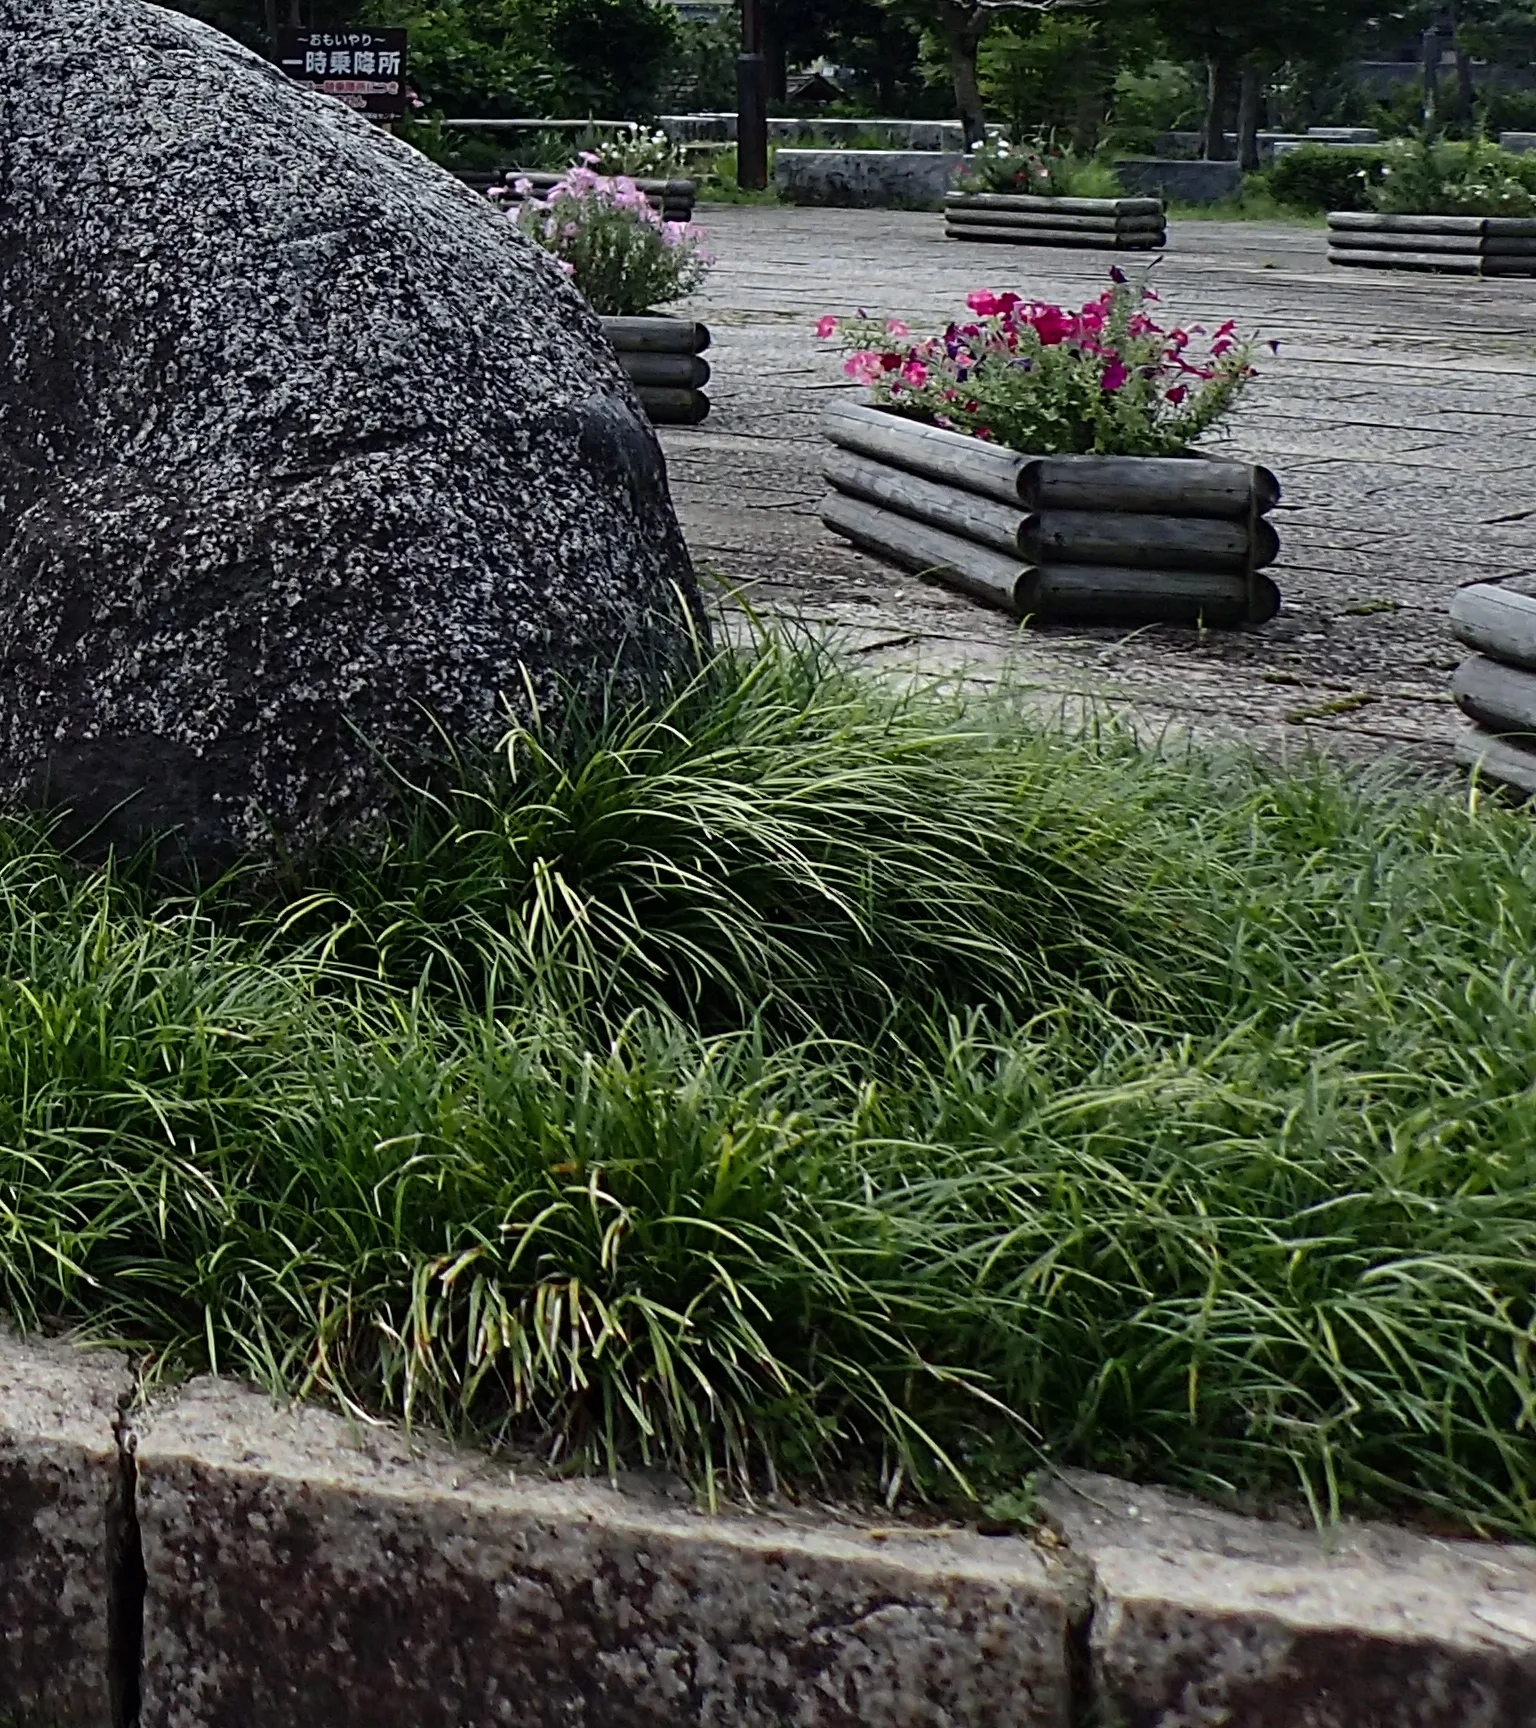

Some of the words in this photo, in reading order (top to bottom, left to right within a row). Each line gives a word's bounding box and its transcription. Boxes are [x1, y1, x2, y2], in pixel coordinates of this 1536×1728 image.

[281, 50, 401, 76] 一時乗降所
